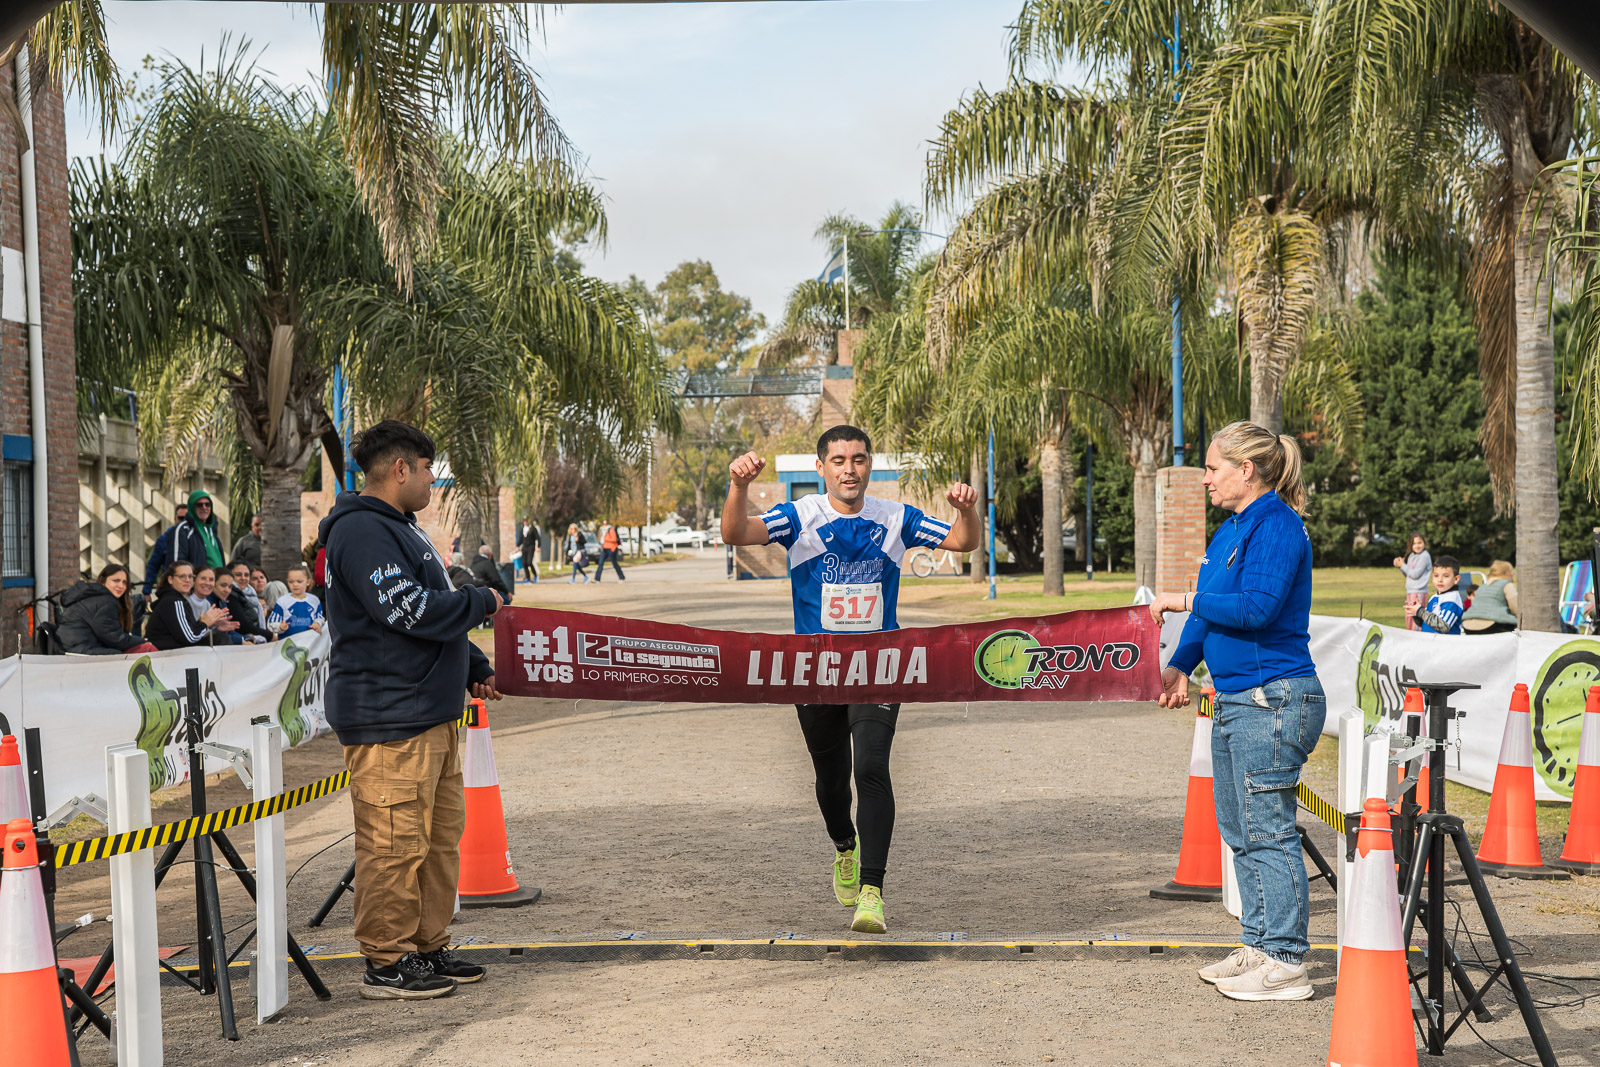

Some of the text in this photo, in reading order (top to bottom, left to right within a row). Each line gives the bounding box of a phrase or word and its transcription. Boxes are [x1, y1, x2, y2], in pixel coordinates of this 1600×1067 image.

[370, 563, 401, 585] El club
[822, 552, 840, 584] 3
[829, 595, 877, 619] 517
[517, 626, 573, 663] #1
[614, 638, 714, 654] GRUPO ASEGURADOR
[636, 652, 715, 669] segunda
[747, 646, 928, 686] LLEGADA
[581, 669, 719, 686] LO PRIMERO SOS VOS
[1020, 675, 1070, 689] RAV
